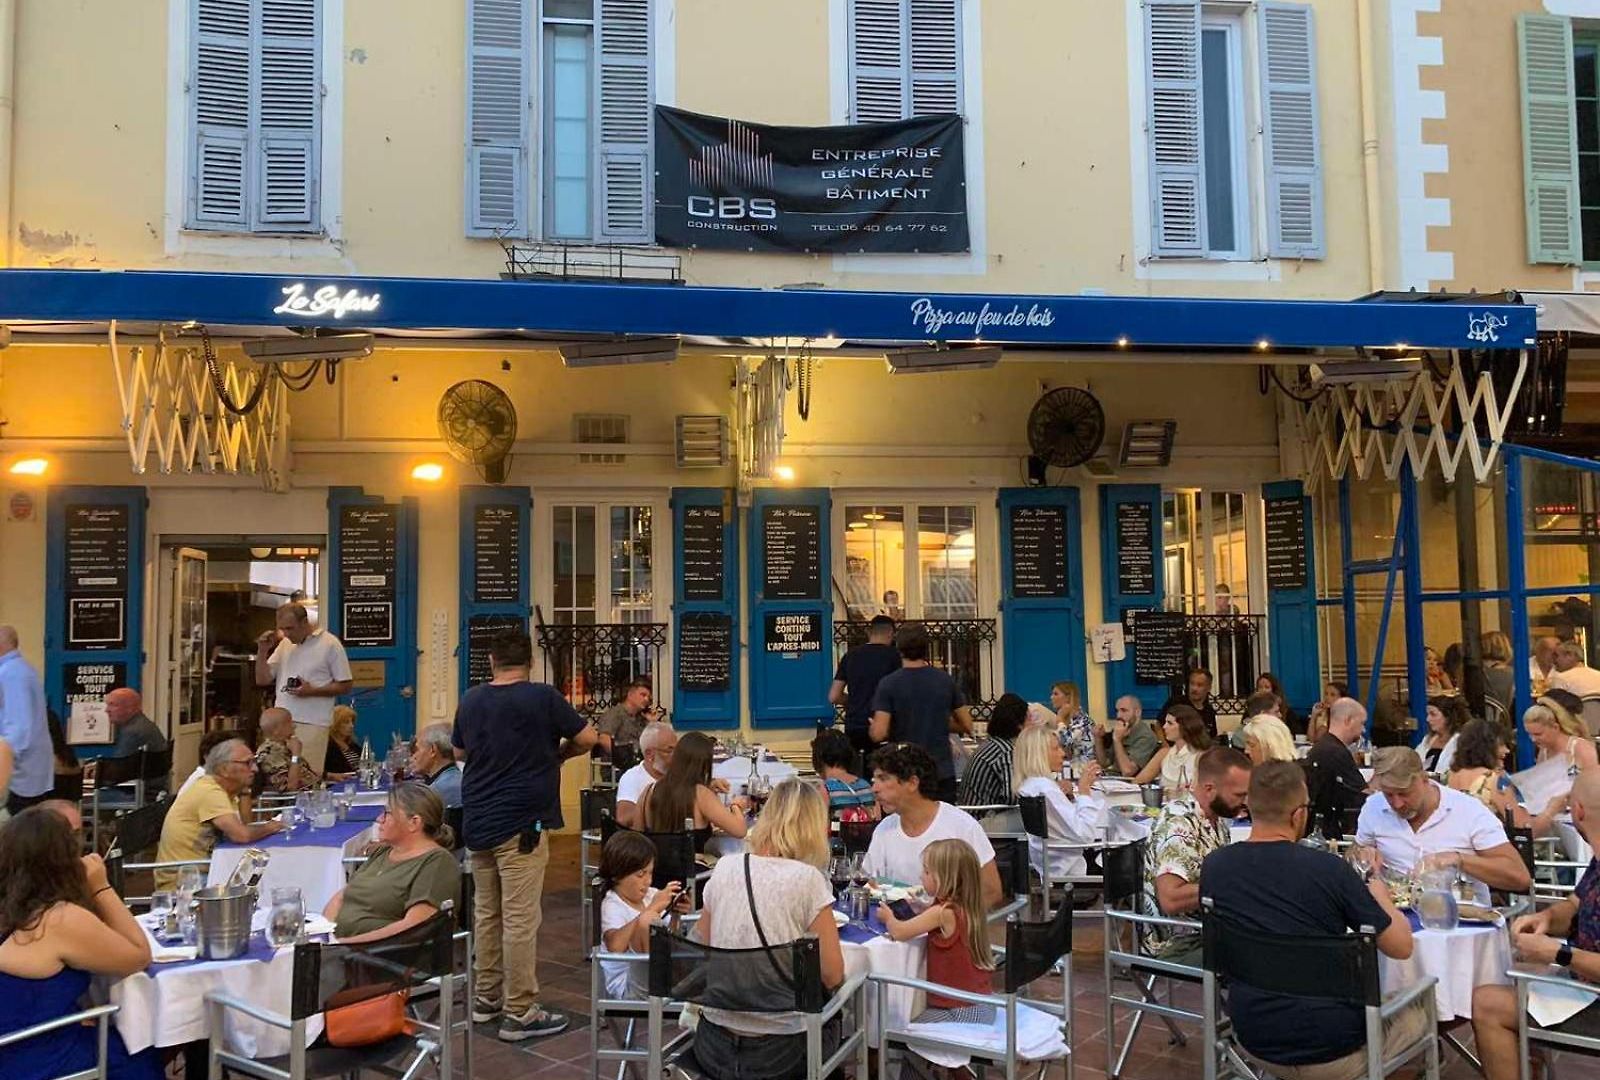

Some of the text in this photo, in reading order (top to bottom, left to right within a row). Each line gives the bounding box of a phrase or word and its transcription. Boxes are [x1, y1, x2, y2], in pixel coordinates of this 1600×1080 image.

[811, 146, 943, 161] ENTREPRISE
[821, 165, 934, 180] GÉNÉRALE
[826, 185, 931, 201] BÂTIMENT
[687, 195, 777, 219] CBS
[687, 220, 778, 232] CONSTRUCTION
[863, 224, 880, 232] 40
[885, 224, 903, 232] 64
[907, 224, 925, 232] 77
[930, 224, 948, 232] 62
[273, 283, 381, 319] Le Safari
[910, 298, 1056, 335] Pizza au feu de bois
[776, 615, 810, 625] SERVICE
[775, 624, 811, 633] CONTINU
[783, 633, 804, 642] TOUT
[77, 665, 114, 674] SERVICE
[75, 674, 116, 684] CONTINU
[84, 684, 107, 693] TOUT
